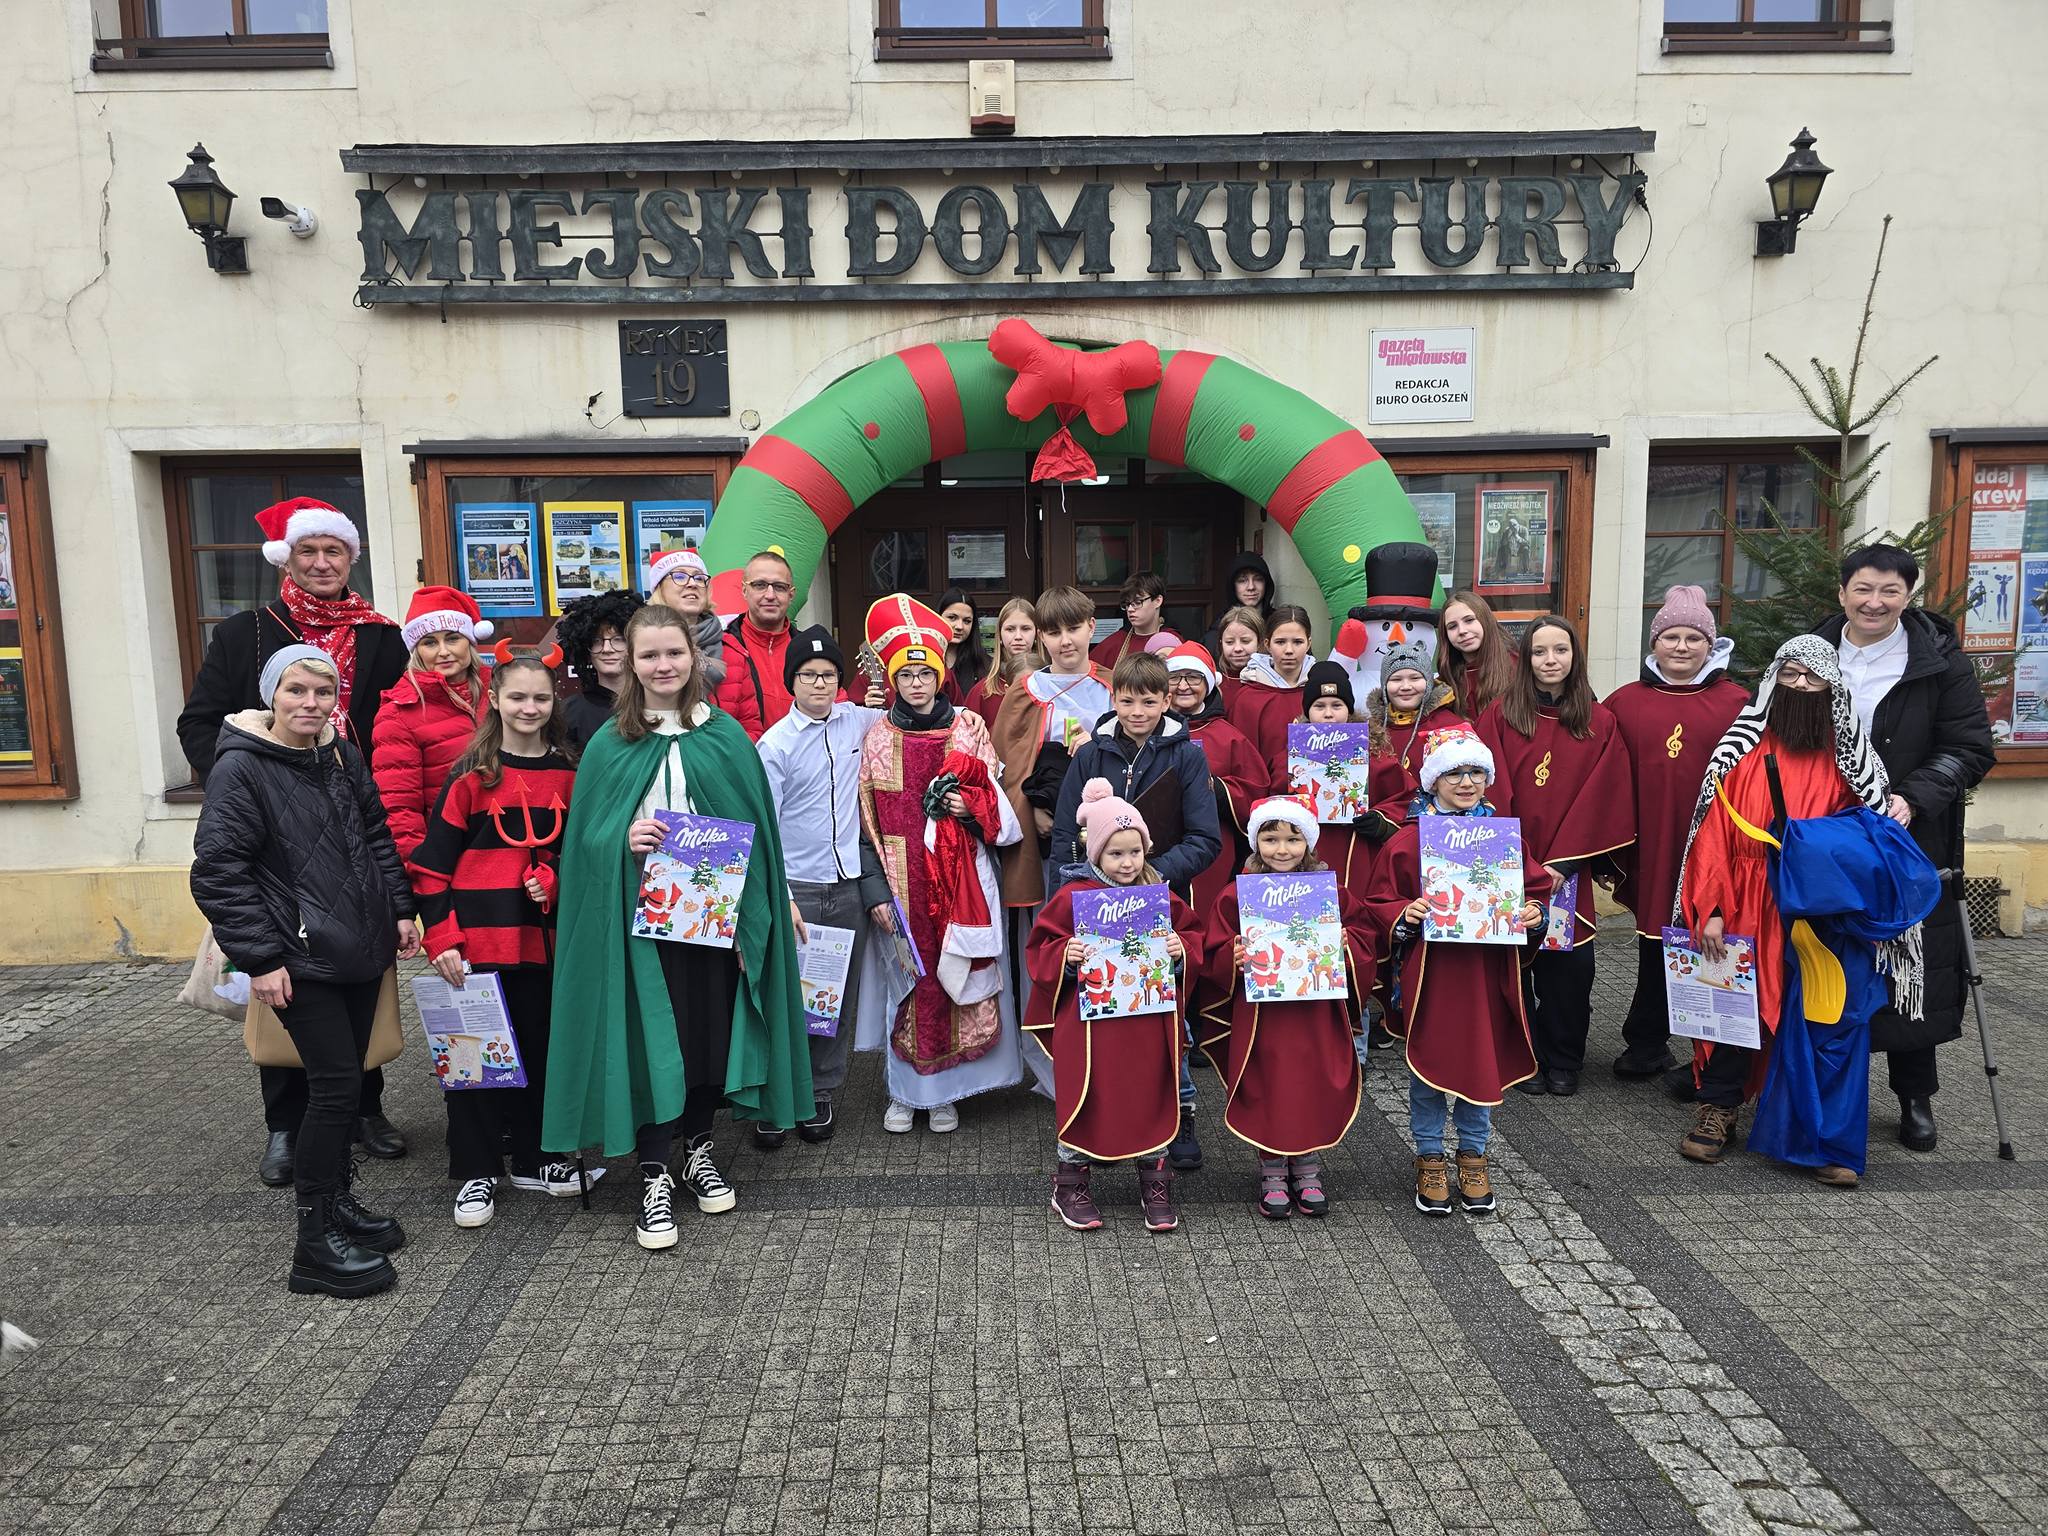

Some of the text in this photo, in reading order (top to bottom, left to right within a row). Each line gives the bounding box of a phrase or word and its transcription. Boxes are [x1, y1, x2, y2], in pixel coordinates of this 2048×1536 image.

[355, 174, 1647, 282] MIEJSKI DOM KULTURY
[625, 328, 721, 355] RYNEK
[1378, 338, 1425, 359] gazeta
[652, 360, 697, 406] 19
[1395, 379, 1450, 390] REDAKCJA
[1376, 391, 1469, 405] BIURO OGŁOSZEŃ
[1520, 500, 1542, 509] WOJTEK
[1972, 488, 2023, 505] krew
[1964, 635, 2013, 648] ichauer
[1307, 730, 1350, 751] Milka
[675, 827, 730, 849] Milka
[1444, 826, 1498, 849] Milka
[1262, 881, 1314, 908] Milka
[1097, 896, 1148, 924] Milka
